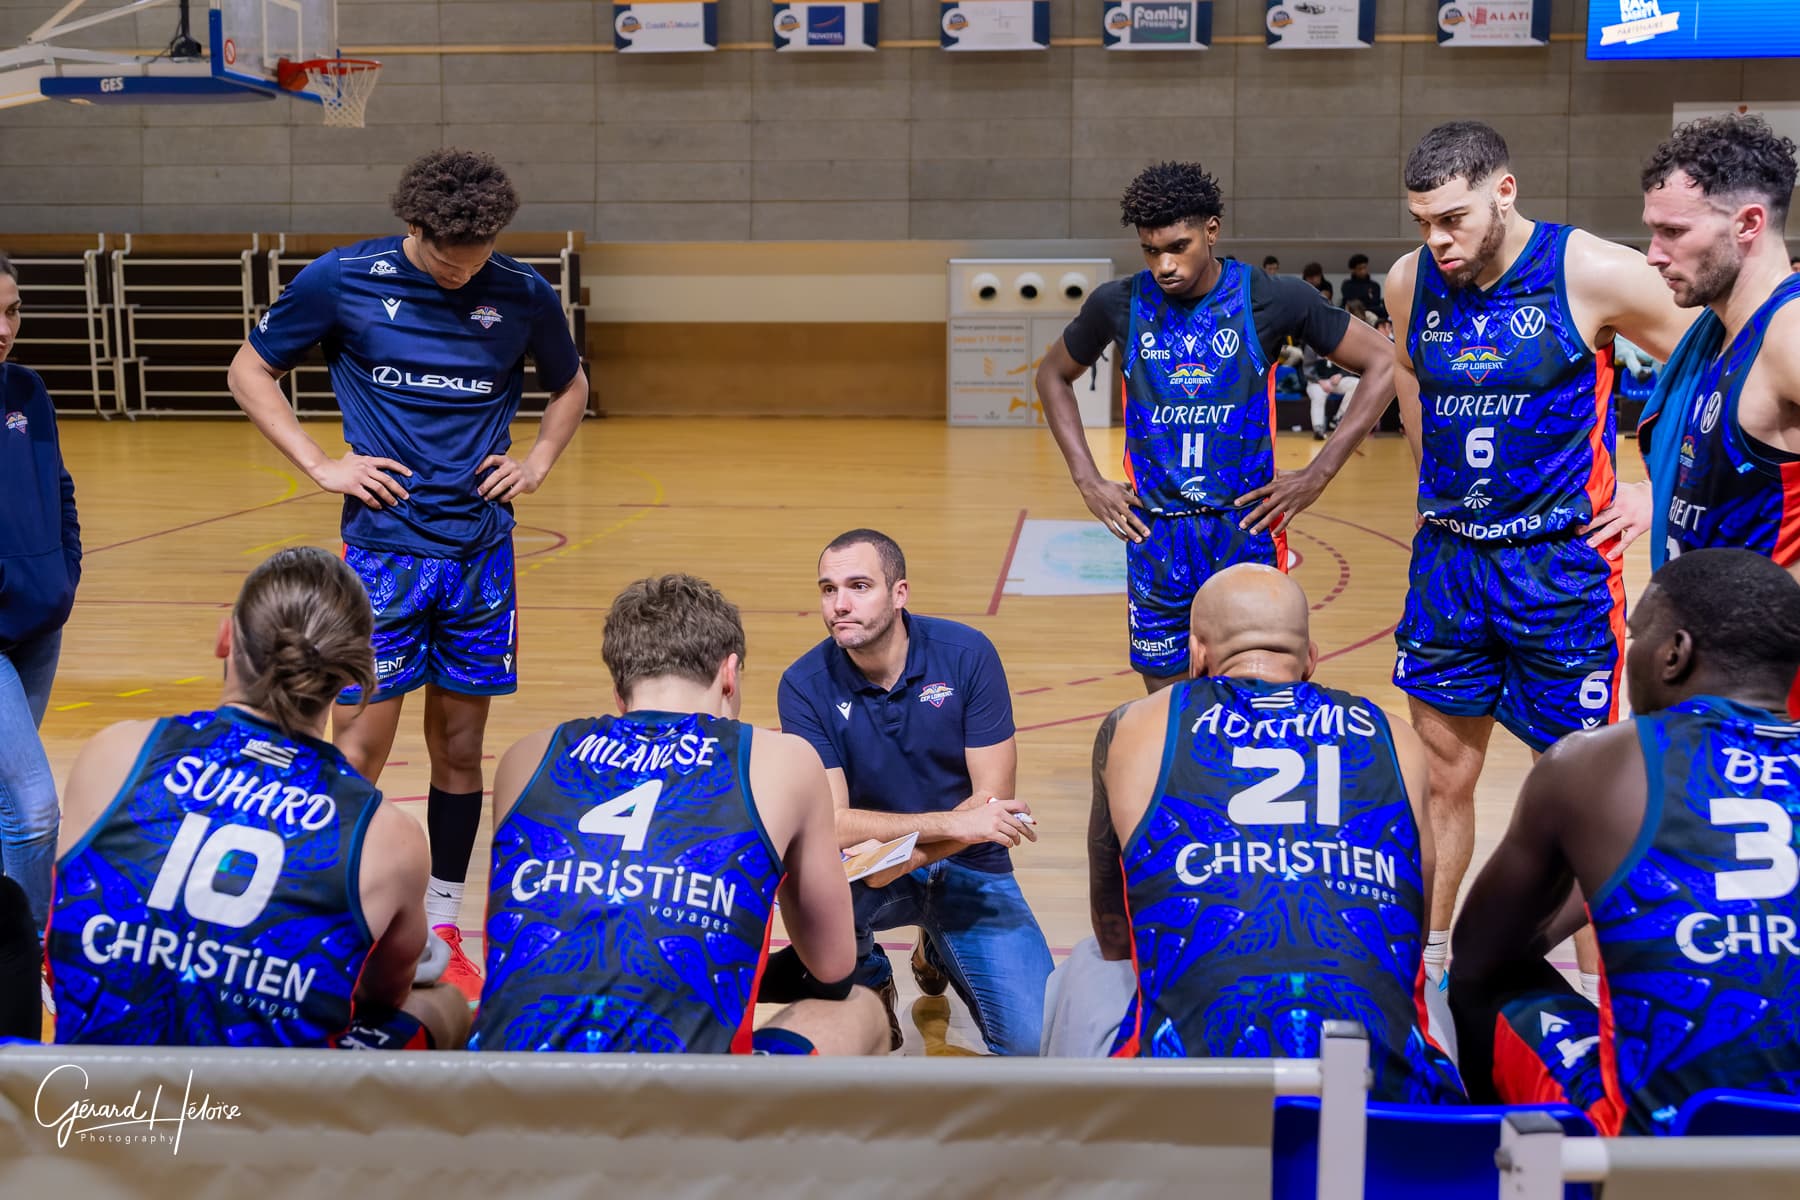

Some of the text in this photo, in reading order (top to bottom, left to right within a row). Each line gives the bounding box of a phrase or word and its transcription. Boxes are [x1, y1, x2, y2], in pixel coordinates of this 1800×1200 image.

[1134, 6, 1187, 29] Family
[101, 77, 124, 92] GES
[1422, 330, 1454, 342] ORTIS
[1140, 348, 1171, 360] ORTIS
[406, 371, 494, 394] LEXUS
[1151, 404, 1236, 425] LORIENT
[1434, 394, 1531, 417] LORIENT
[1465, 427, 1495, 469] 6
[1579, 670, 1612, 710] 6
[163, 755, 337, 831] SUHARD
[1227, 744, 1341, 826] 21
[577, 779, 663, 851] 4
[146, 811, 286, 929] 10
[1324, 878, 1398, 905] voyages
[649, 904, 730, 934] voyages
